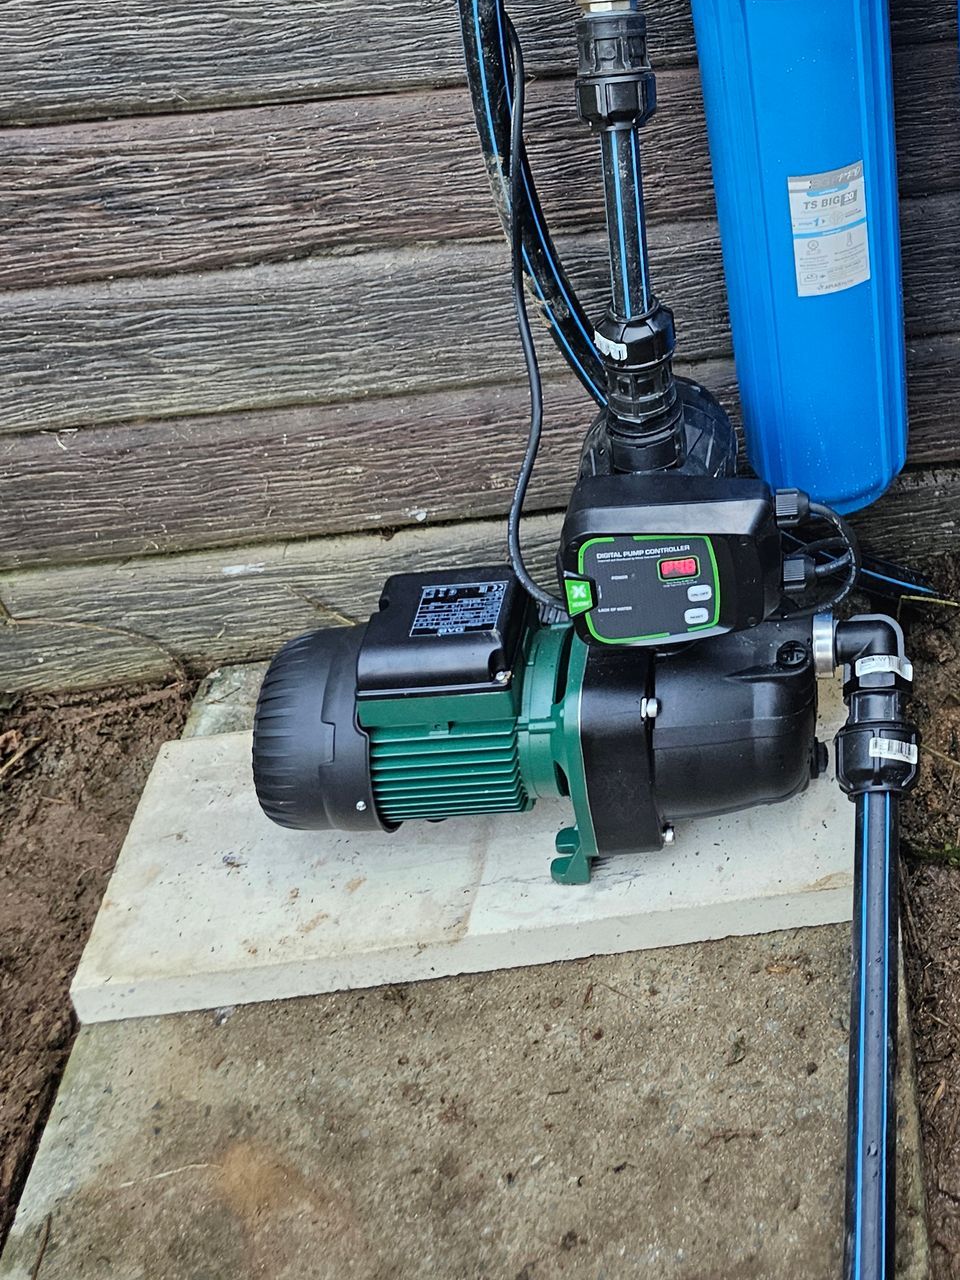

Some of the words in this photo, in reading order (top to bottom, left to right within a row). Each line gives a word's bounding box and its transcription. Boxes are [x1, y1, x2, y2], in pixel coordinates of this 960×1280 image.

[803, 200, 818, 211] TS
[821, 195, 840, 208] BIG
[596, 552, 623, 560] DIGITAL
[623, 549, 645, 558] PUMP
[645, 544, 690, 556] CONTROLLER
